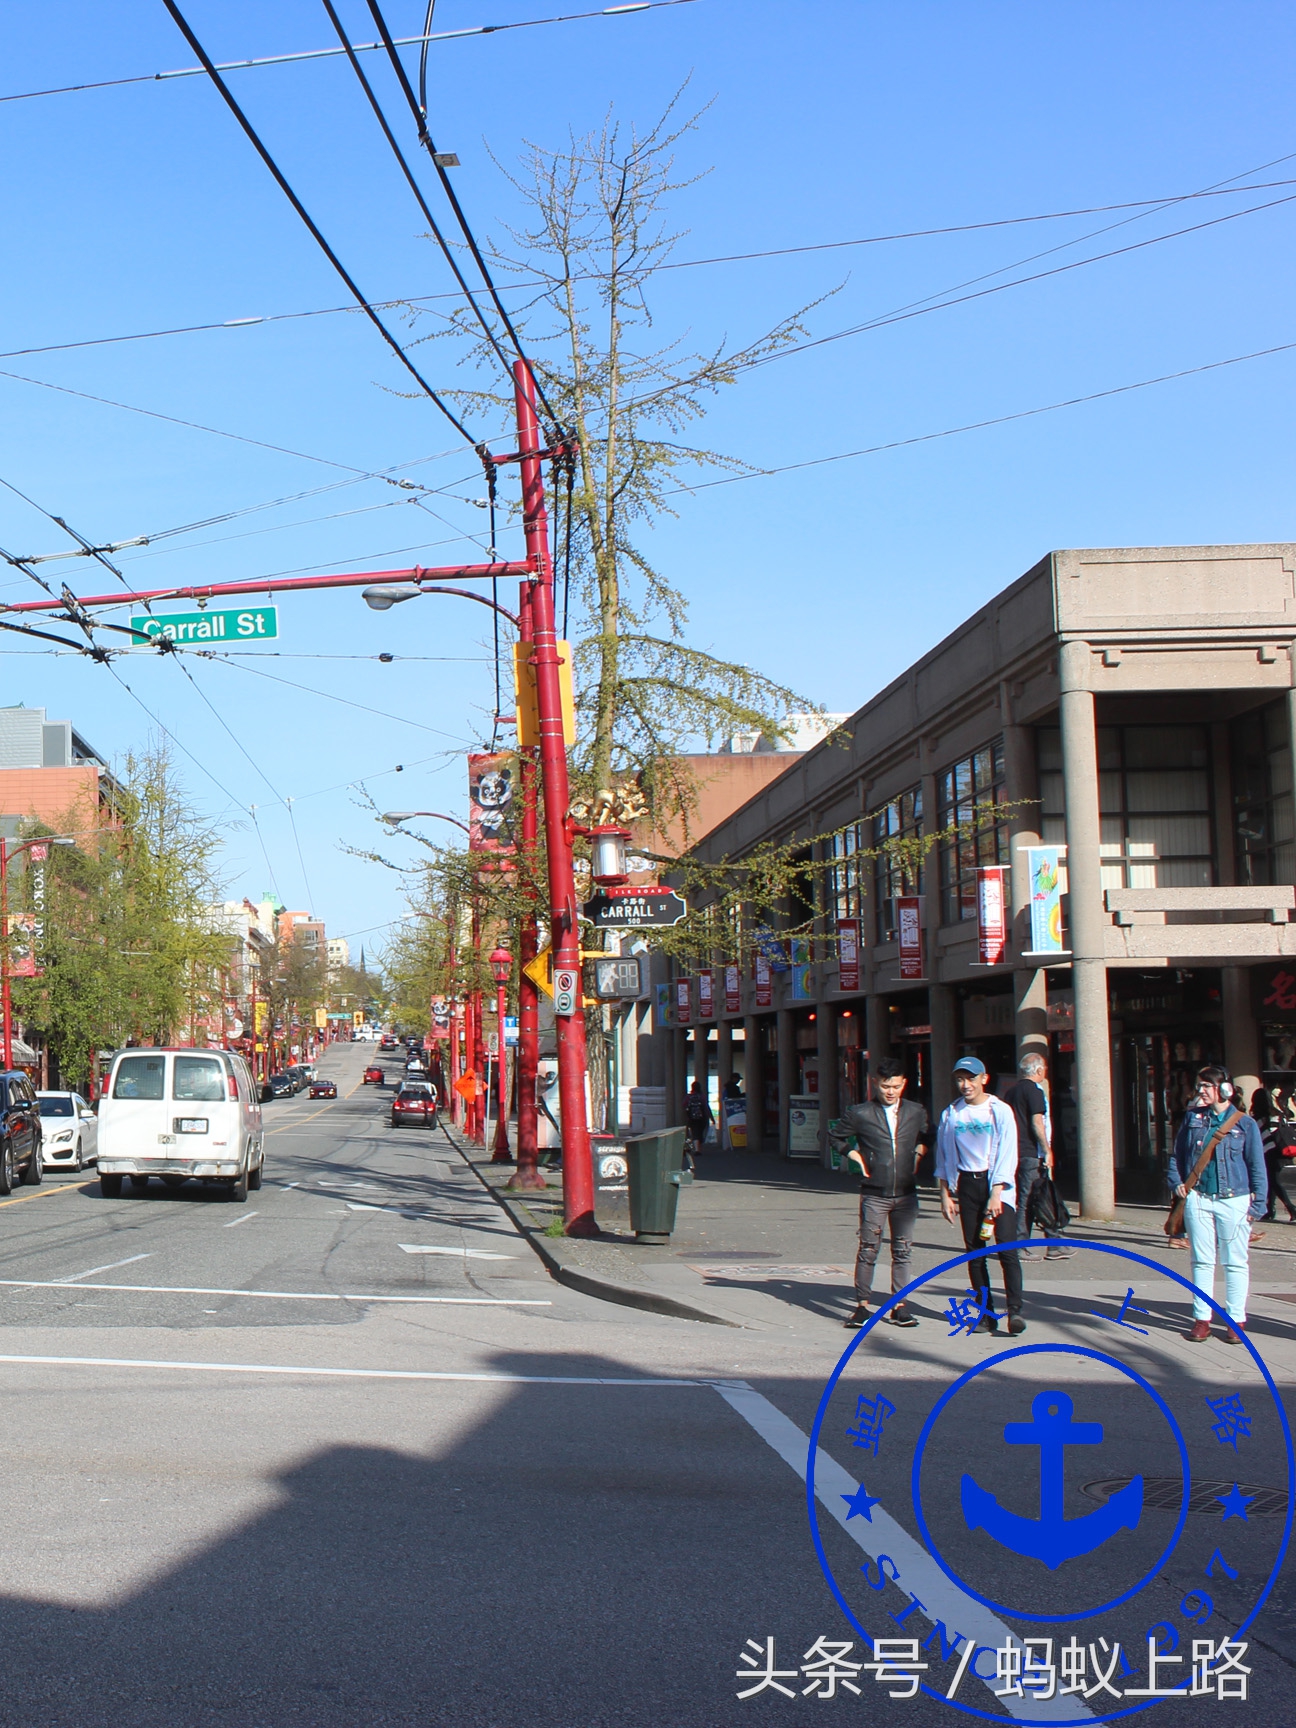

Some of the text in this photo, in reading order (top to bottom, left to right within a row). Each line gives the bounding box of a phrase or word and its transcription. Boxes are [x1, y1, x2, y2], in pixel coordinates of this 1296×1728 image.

[142, 613, 266, 643] Carrall St
[637, 886, 663, 894] ROAD
[600, 904, 655, 919] CARRALL
[627, 917, 641, 925] 500
